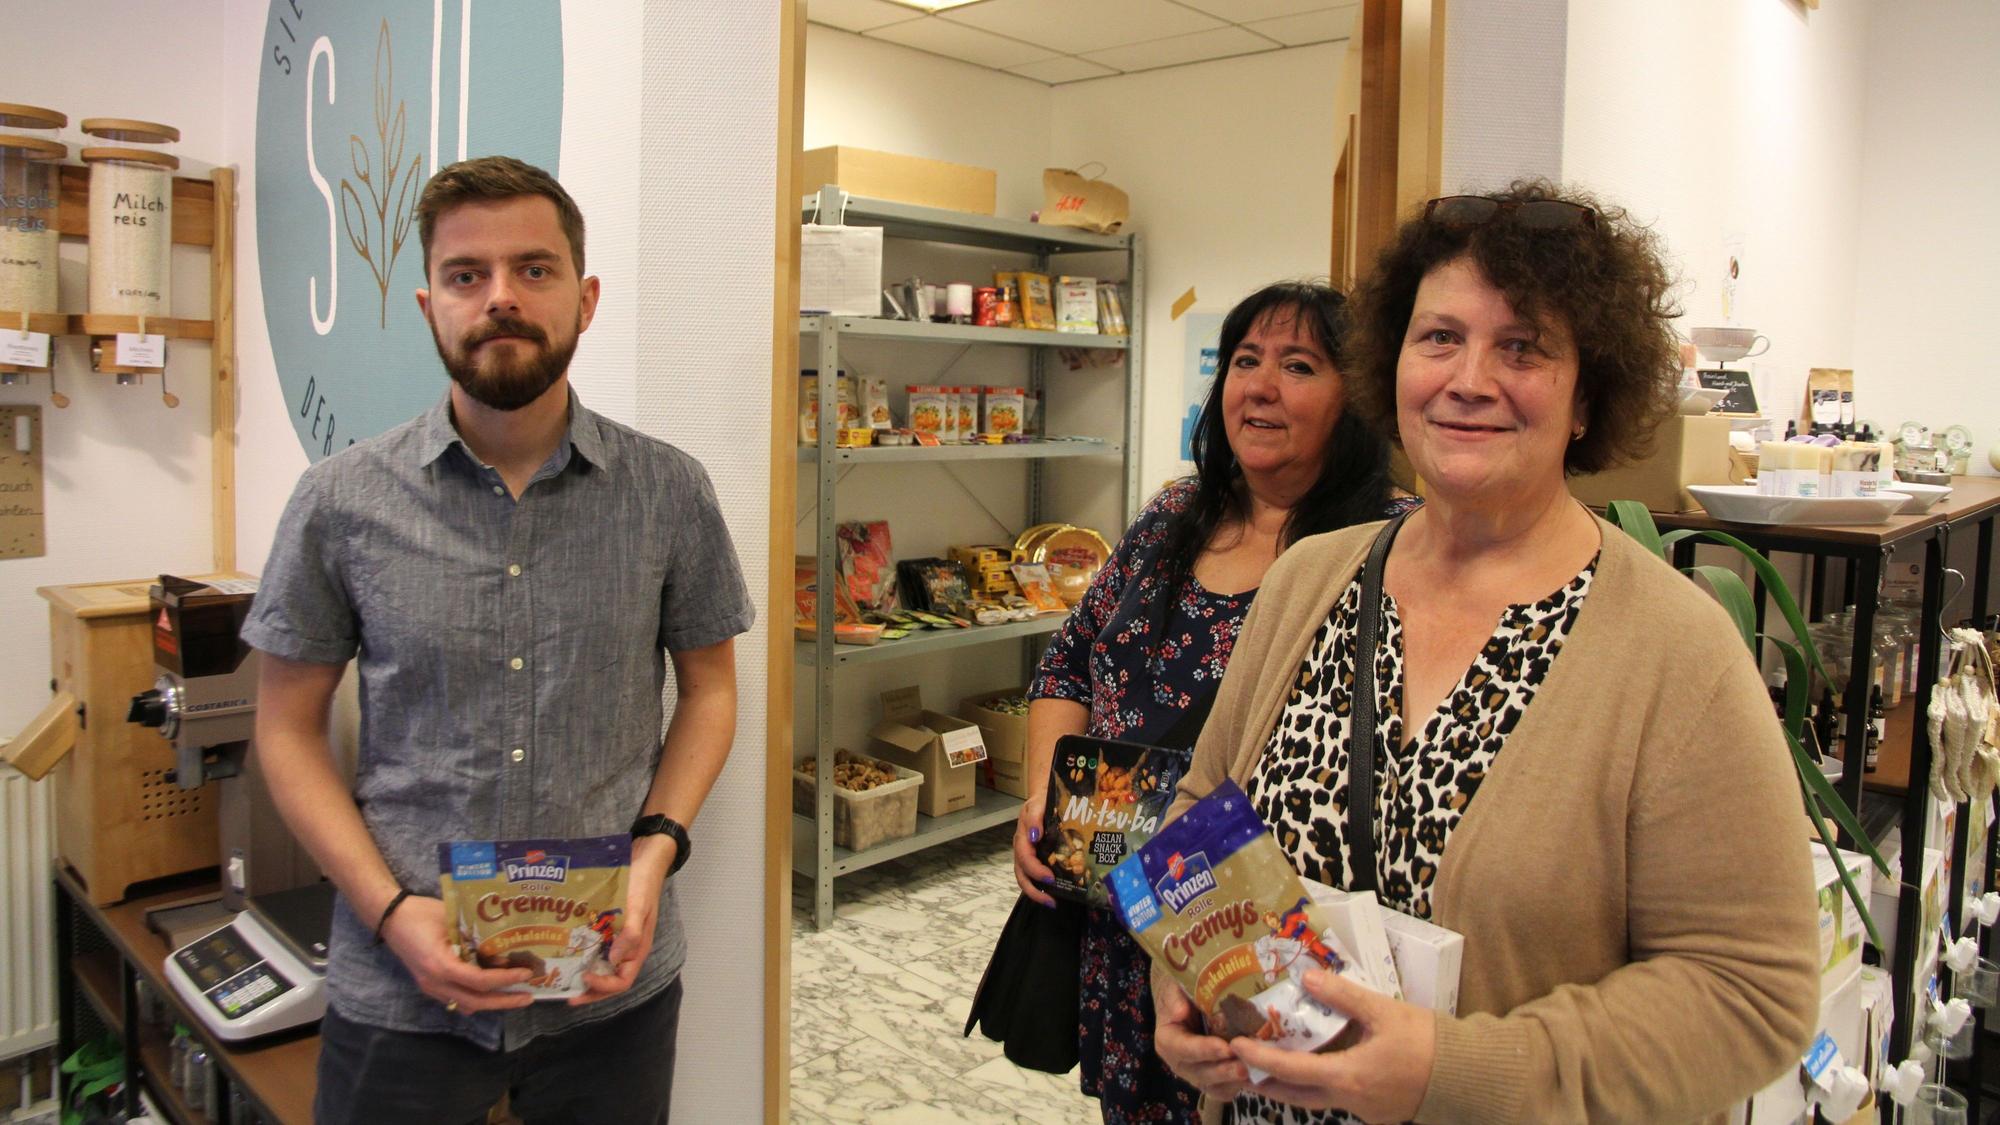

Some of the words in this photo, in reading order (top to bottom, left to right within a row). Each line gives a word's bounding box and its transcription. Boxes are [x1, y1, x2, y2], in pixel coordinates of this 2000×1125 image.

[114, 211, 148, 227] reis
[1095, 833, 1122, 844] ASIAN
[1093, 843, 1122, 854] SNACK
[1098, 853, 1116, 864] BOX
[507, 863, 564, 879] Prinzen
[520, 883, 552, 892] Rolle
[1163, 869, 1213, 911] Prinzen
[477, 892, 589, 923] Cremys
[1128, 895, 1152, 918] WINTER
[1187, 897, 1214, 919] Rolle
[1131, 904, 1157, 929] EDITION
[1162, 898, 1259, 972] Cremys
